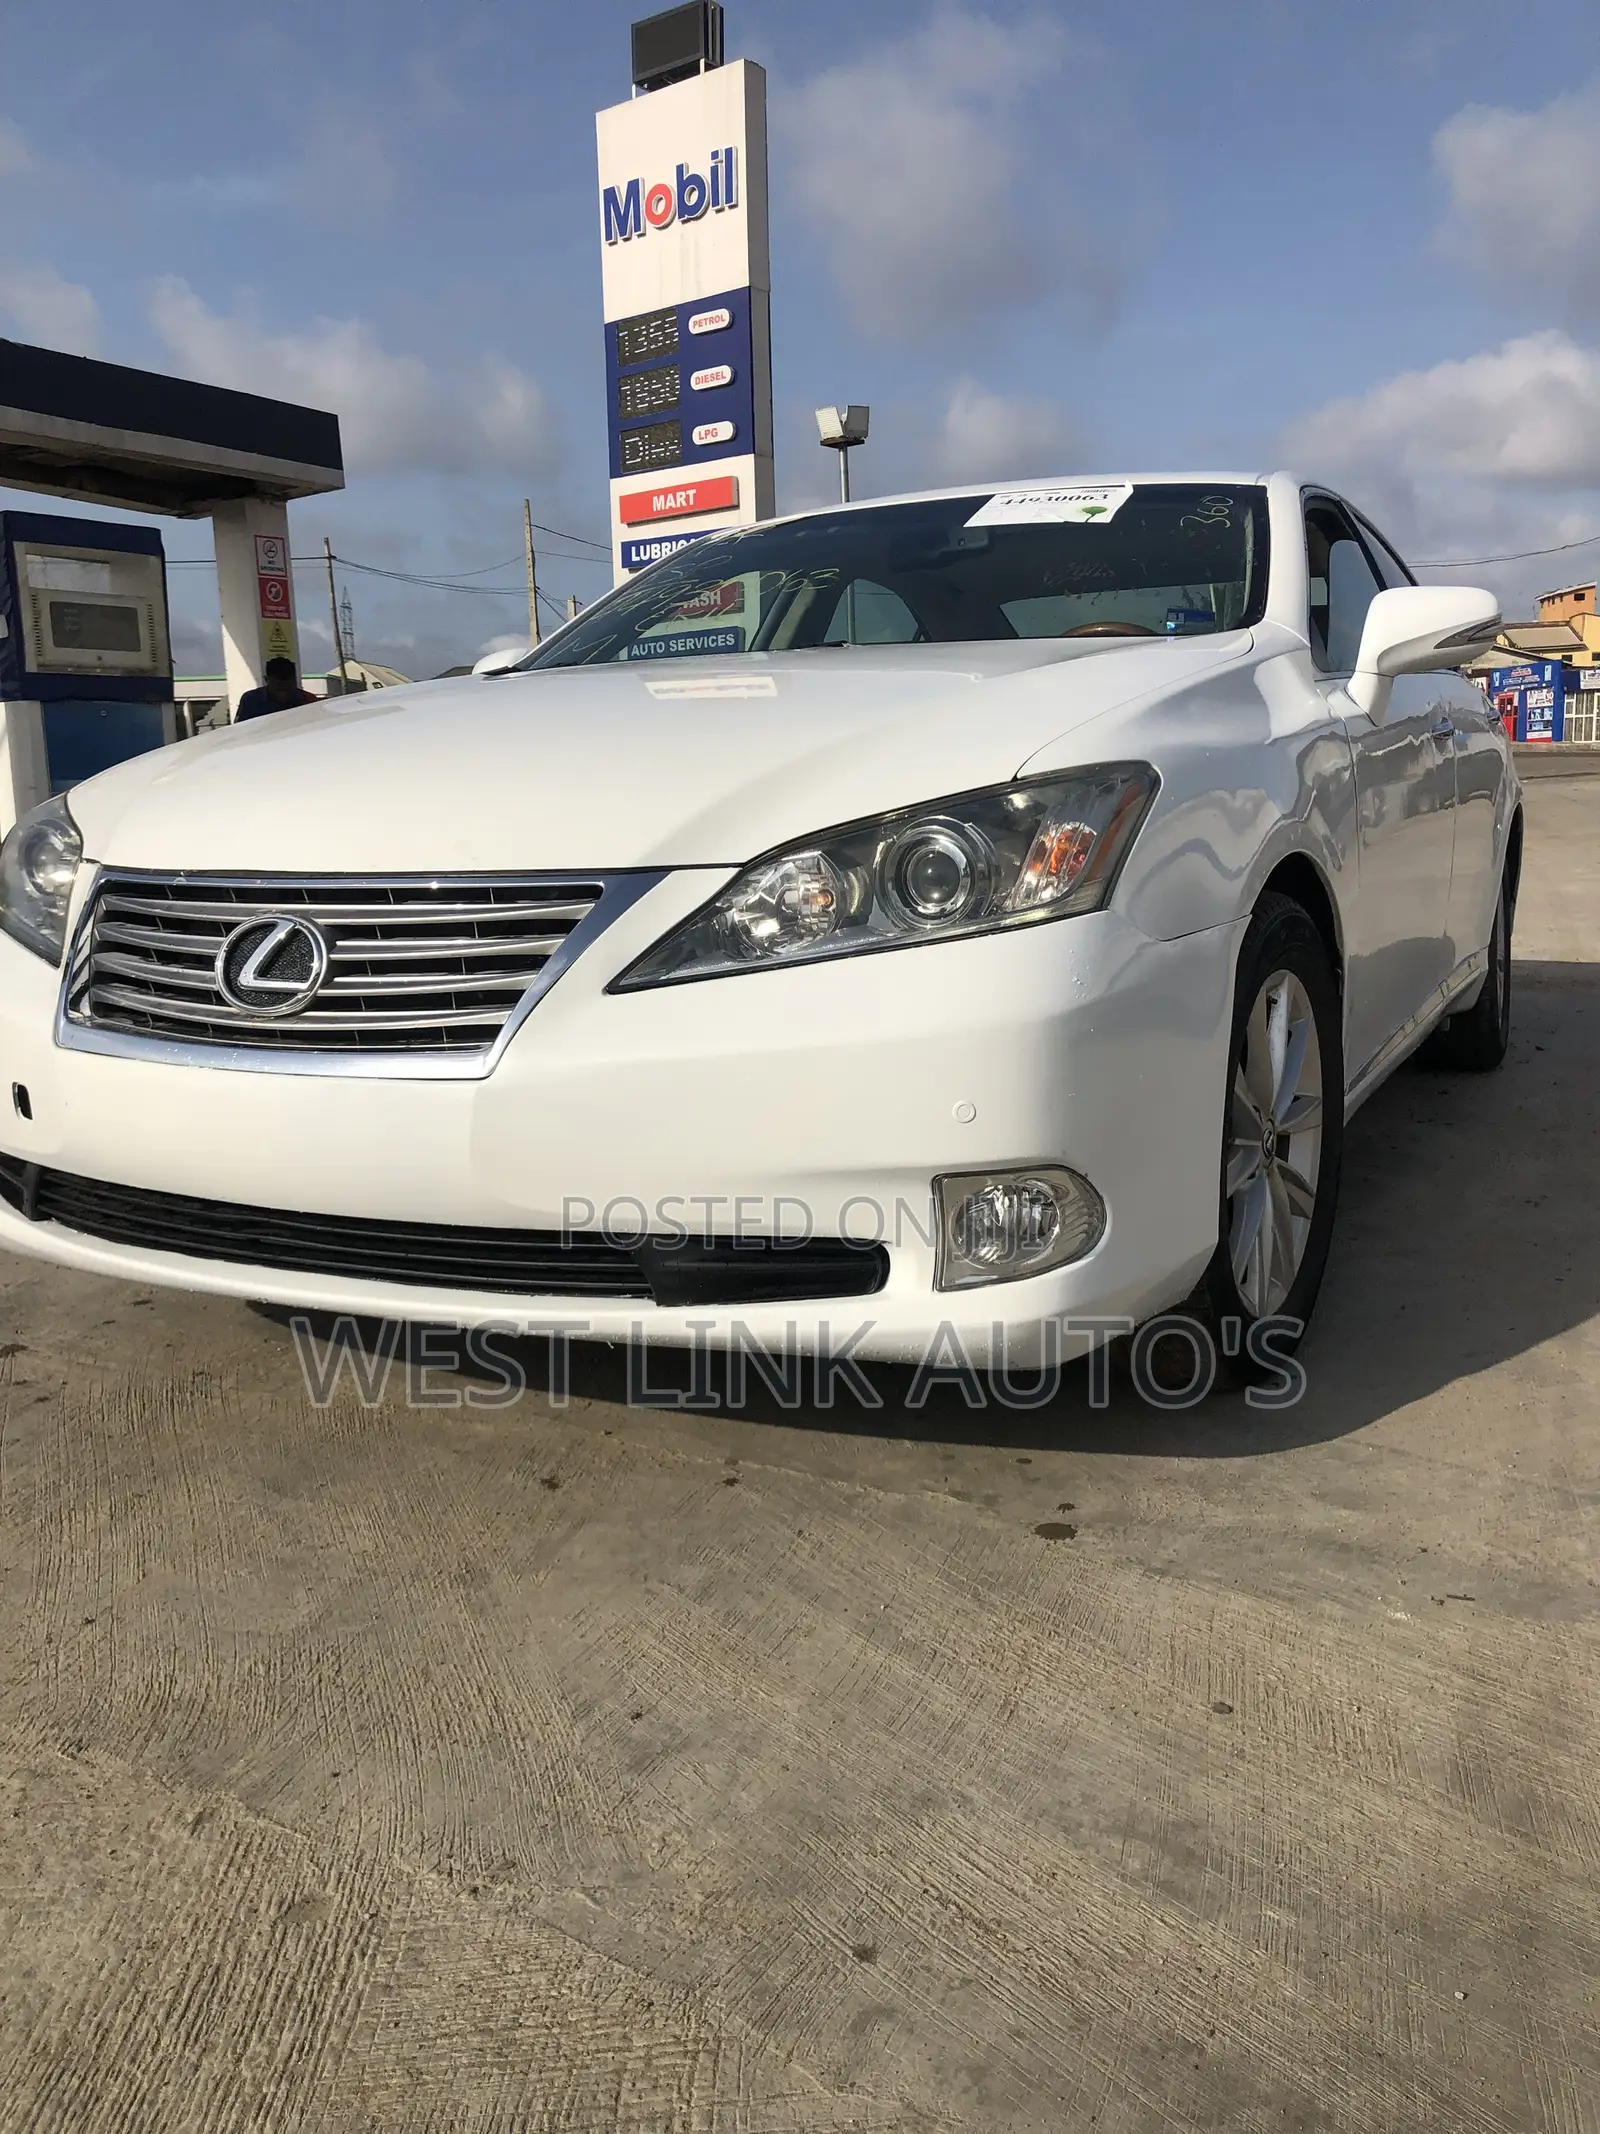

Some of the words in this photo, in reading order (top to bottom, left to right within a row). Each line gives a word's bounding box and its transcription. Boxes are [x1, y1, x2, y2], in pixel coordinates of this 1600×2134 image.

[602, 145, 739, 246] Mobil
[692, 314, 726, 329] PETROL
[694, 371, 727, 386] DIESEL
[698, 427, 719, 441] LPG
[652, 489, 697, 512] MART
[631, 641, 665, 657] AUTO
[669, 633, 735, 653] SERVICES
